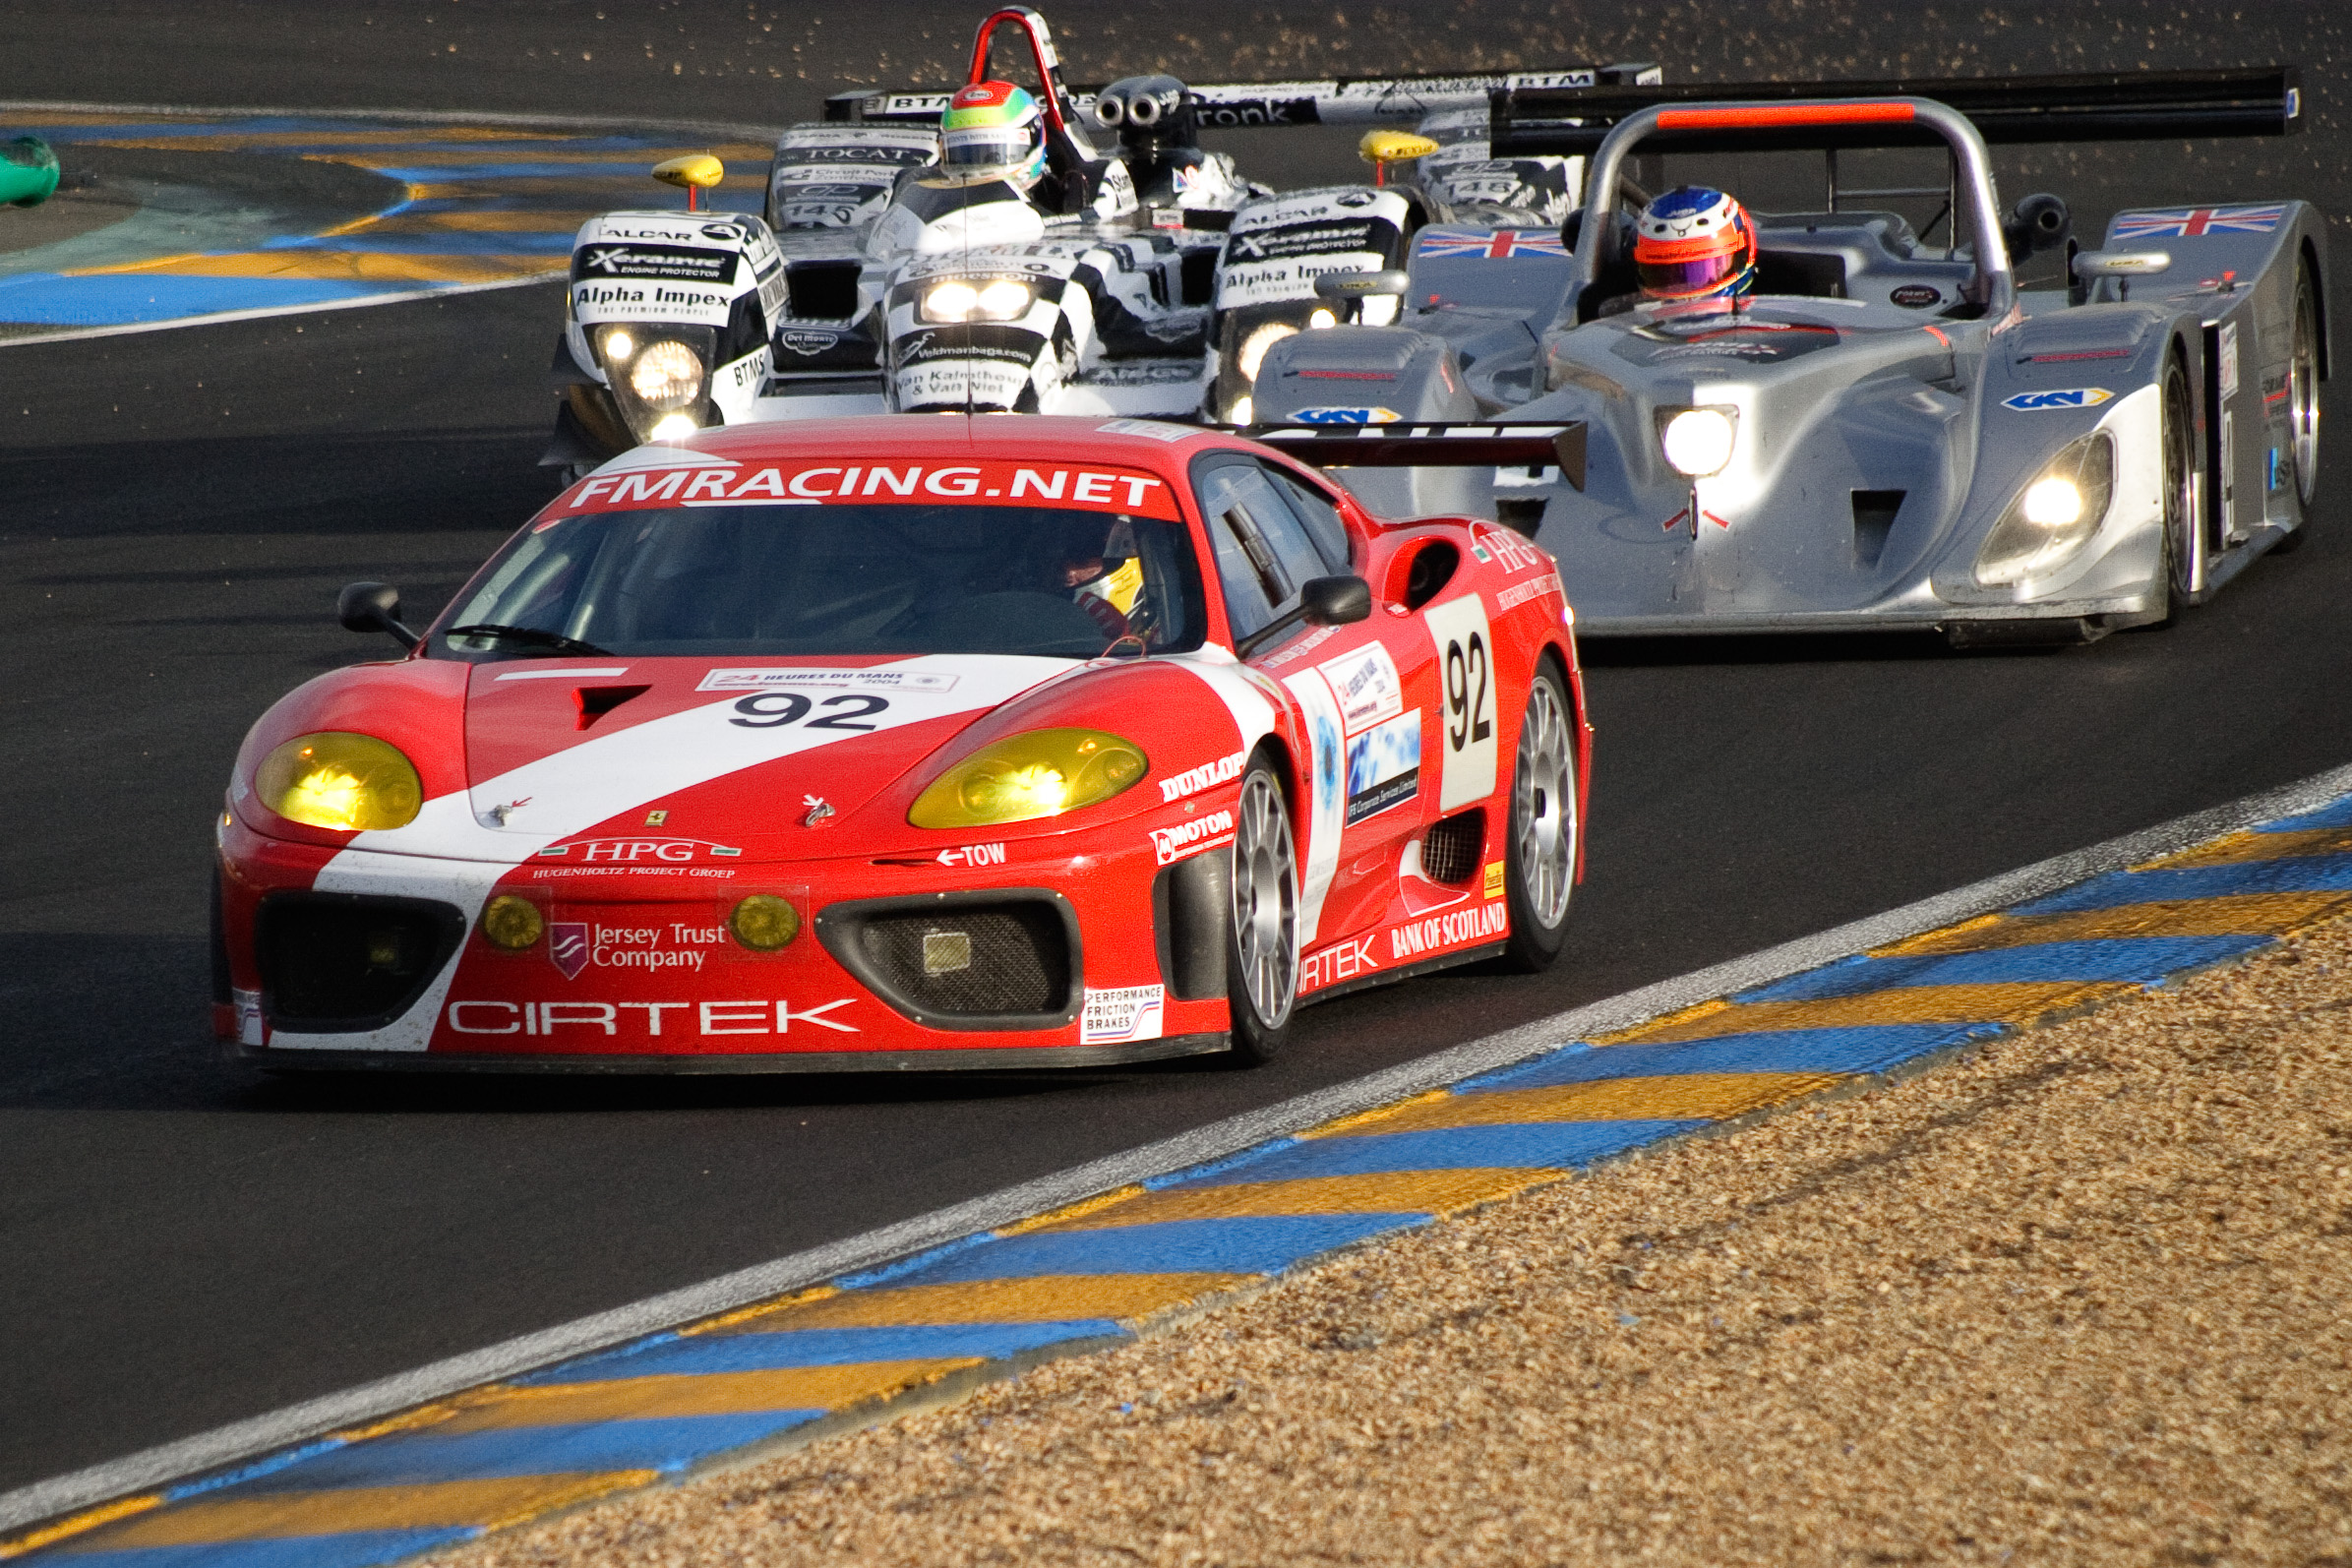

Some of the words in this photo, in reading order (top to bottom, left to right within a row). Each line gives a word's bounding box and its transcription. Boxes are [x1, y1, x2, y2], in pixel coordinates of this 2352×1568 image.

[806, 149, 911, 159] TOCAT
[604, 229, 693, 242] ALCAR
[621, 266, 659, 274] ENGINE
[659, 267, 720, 278] PROTECTOR
[1226, 270, 1287, 288] Alpha
[576, 286, 644, 308] Alpha
[654, 287, 729, 307] Impex
[733, 353, 765, 388] BTMS
[569, 466, 1163, 509] FMRACING.NET
[1447, 631, 1490, 753] 92
[728, 693, 890, 731] 92
[1158, 751, 1244, 803] DUNLOP
[1168, 810, 1234, 847] MOTON
[581, 842, 694, 862] HPG
[960, 843, 1006, 868] TOW
[533, 867, 625, 878] HUGENHOLTZ
[629, 867, 686, 876] PROJECT
[690, 868, 736, 878] GROEP
[592, 923, 661, 949] Jersey
[669, 923, 726, 944] Trust
[1392, 925, 1425, 959] BANK
[1424, 916, 1442, 950] OF
[1442, 902, 1506, 946] SCOTLAND
[592, 945, 706, 972] Company
[1296, 934, 1379, 994] IRTEK
[1086, 987, 1162, 1003] PERFORMANCE
[449, 998, 862, 1036] CIRTEK
[1086, 1003, 1135, 1017] FRICTION
[1086, 1016, 1131, 1030] BRAKES
